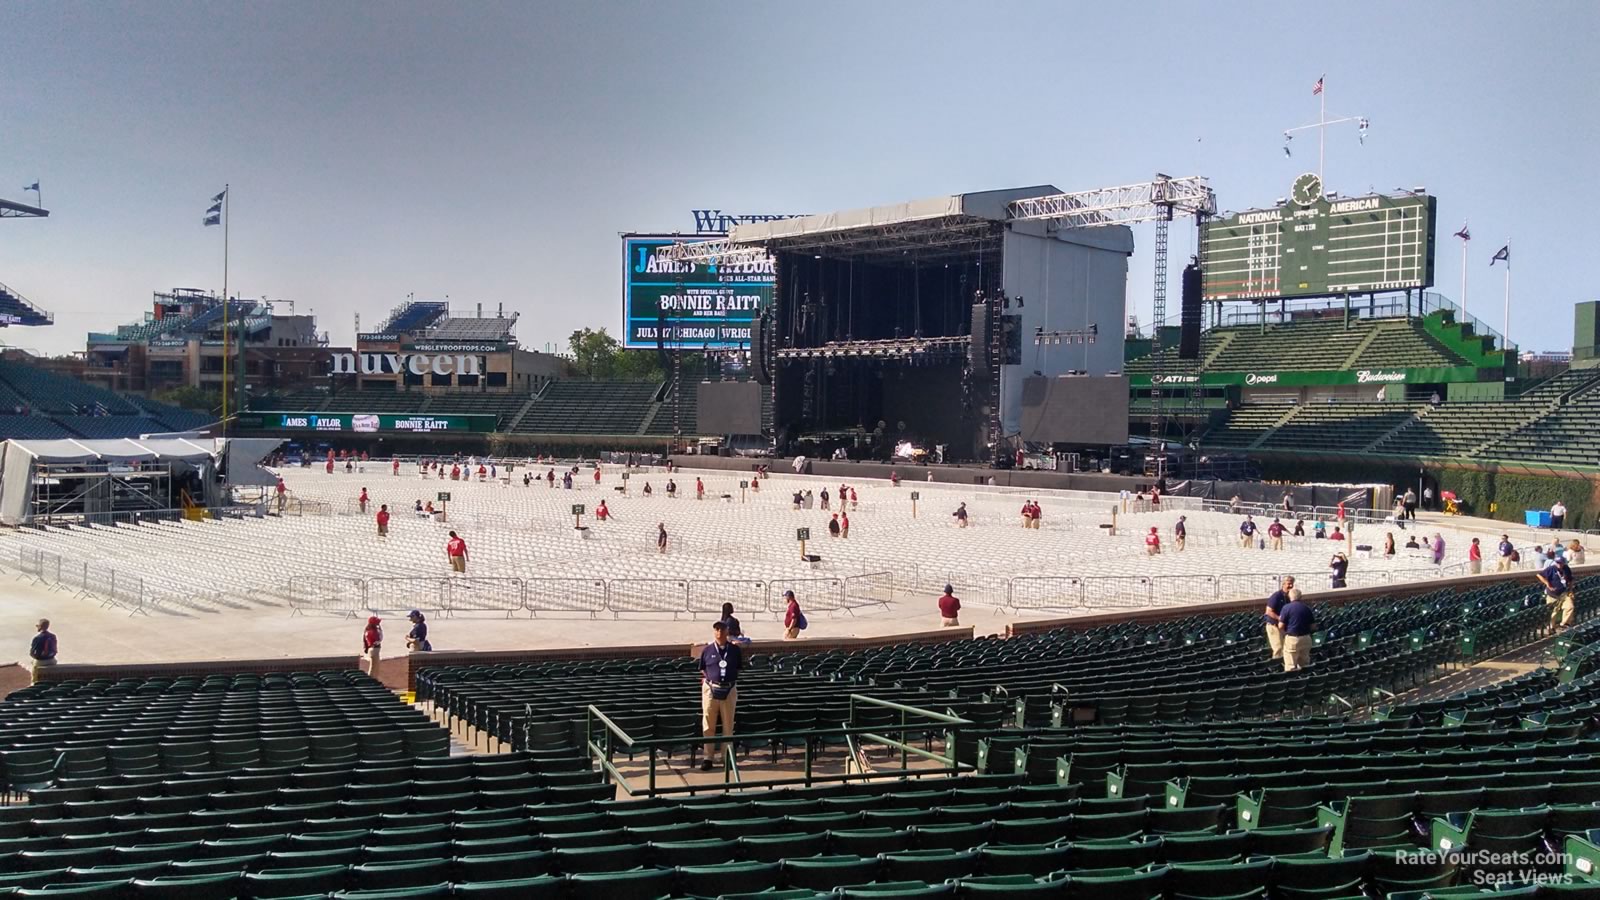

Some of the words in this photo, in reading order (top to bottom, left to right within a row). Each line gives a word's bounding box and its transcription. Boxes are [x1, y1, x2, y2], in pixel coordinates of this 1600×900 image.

[1330, 198, 1379, 213] AMERICAN
[1239, 211, 1283, 224] NATIONAL
[660, 295, 711, 310] BONNIE
[716, 295, 760, 310] RAITT
[637, 327, 658, 338] JULY
[678, 328, 715, 338] CHICAGO
[332, 352, 481, 376] nuveen
[1257, 374, 1277, 384] pepsi
[1356, 370, 1406, 383] Budweiser
[281, 415, 307, 427] JAMES
[310, 415, 341, 427] TAYLOR
[395, 420, 423, 429] BONNIE
[425, 420, 448, 429] RAITT
